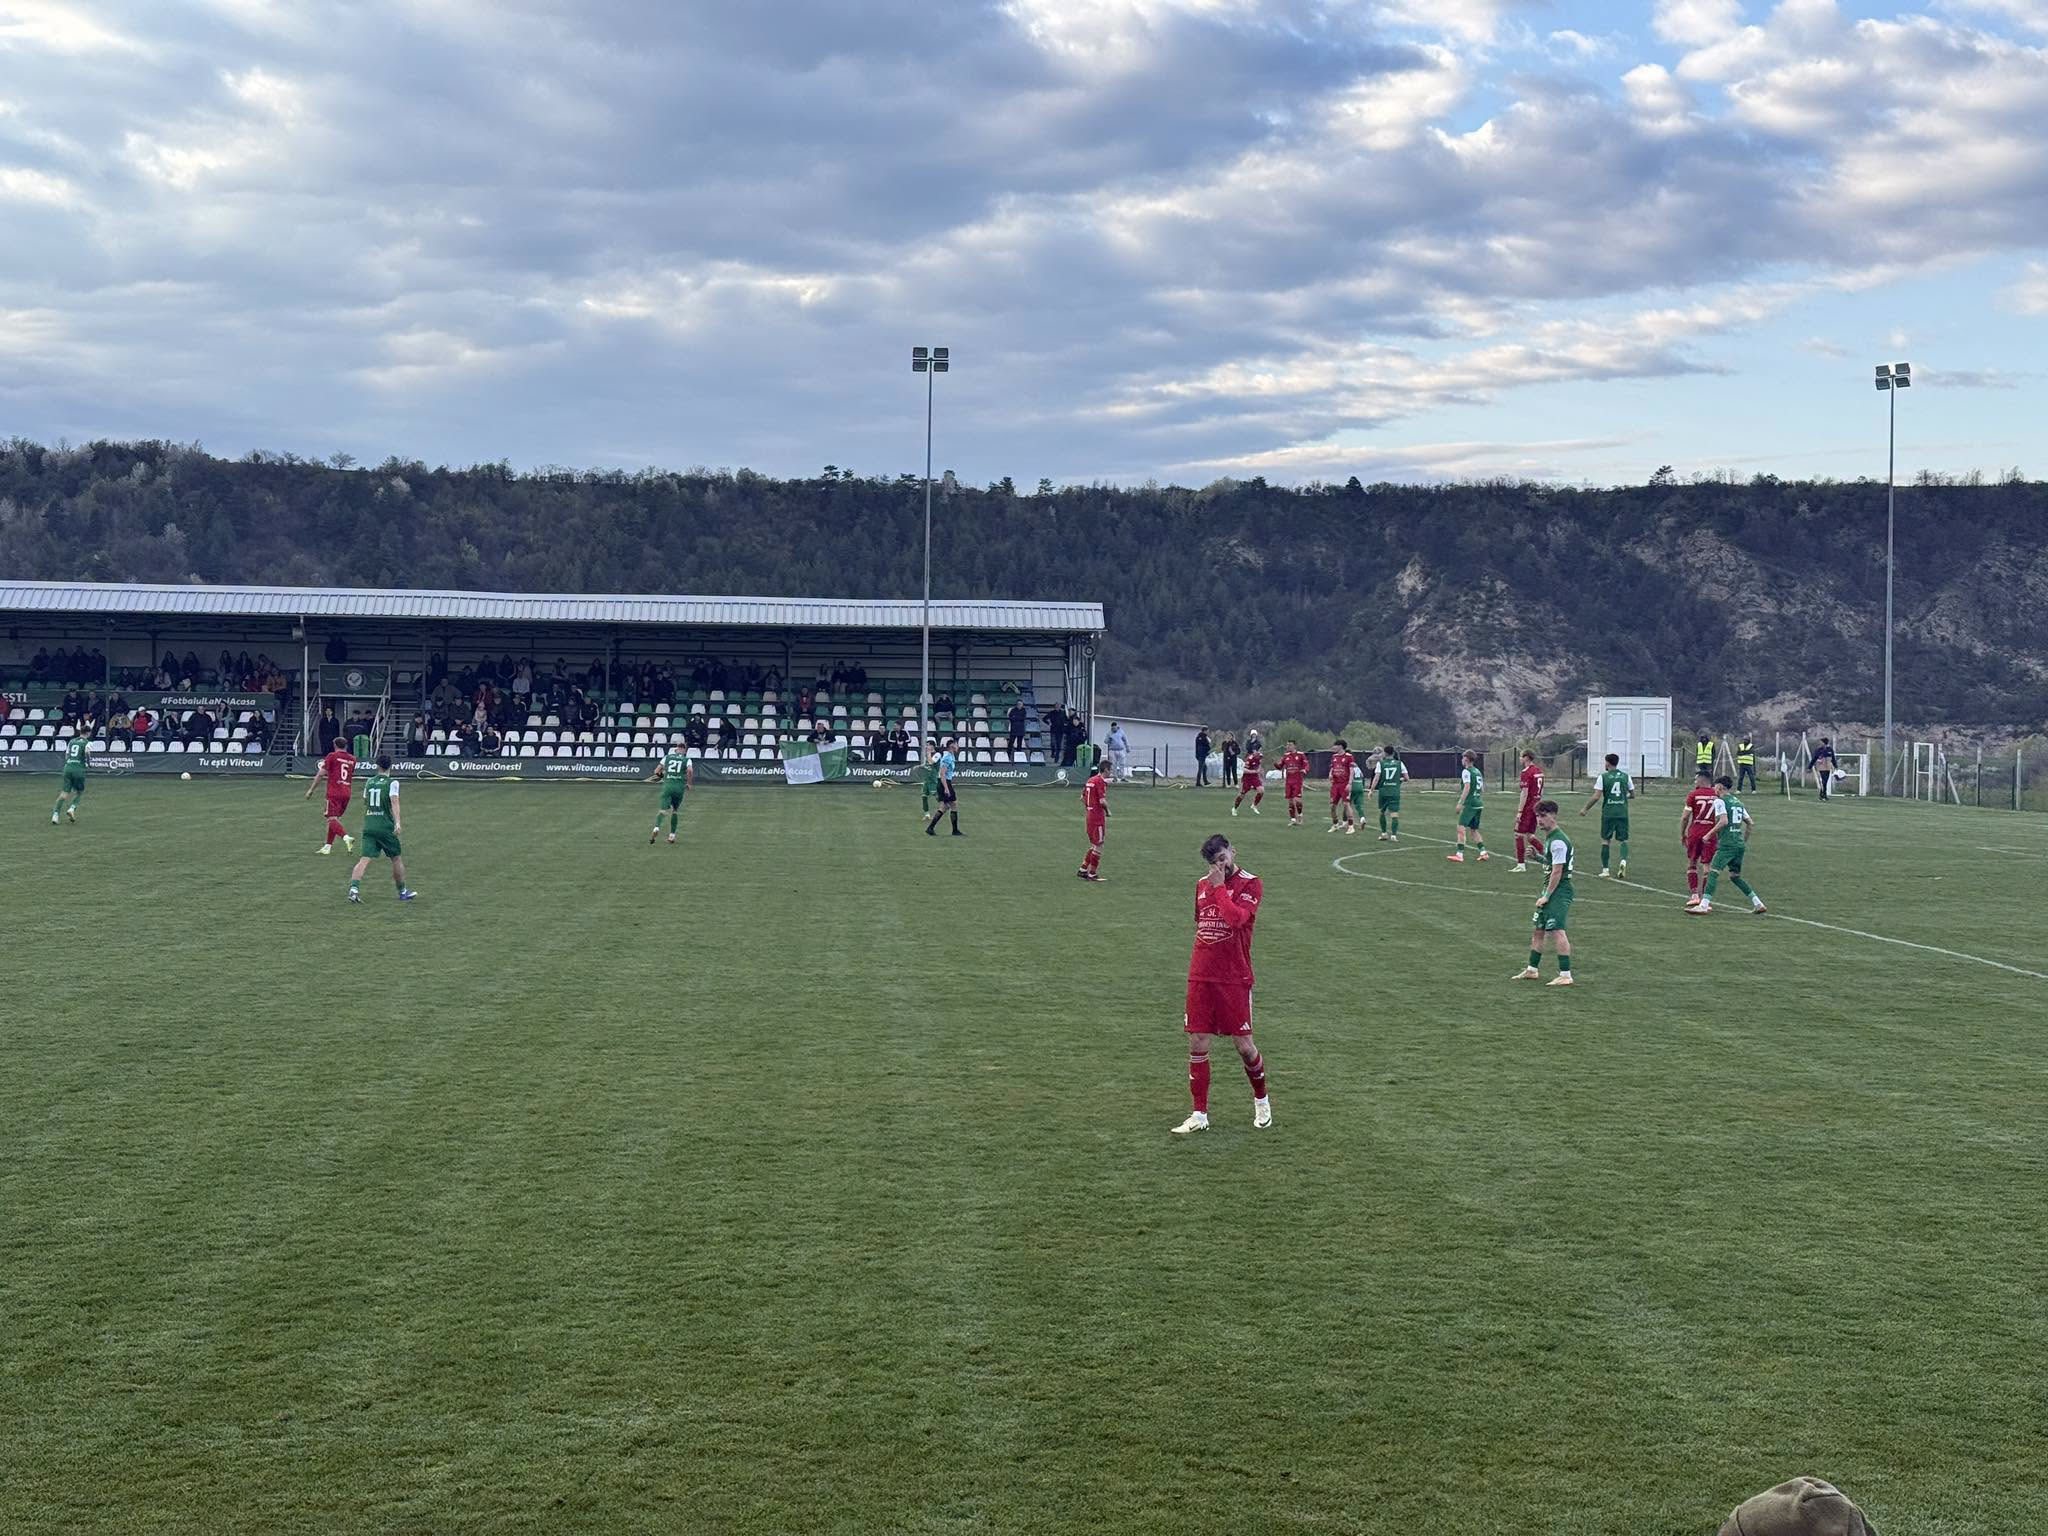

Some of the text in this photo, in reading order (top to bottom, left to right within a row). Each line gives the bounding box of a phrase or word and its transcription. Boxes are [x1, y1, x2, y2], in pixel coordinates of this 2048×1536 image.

[70, 744, 80, 758] 9
[199, 758, 209, 767] Tu
[229, 759, 264, 768] Viitorul
[460, 762, 522, 771] ViitorulOnesti
[545, 763, 640, 774] www.viitorulonesti.ro
[667, 759, 683, 773] 21
[340, 763, 349, 781] 6
[852, 768, 912, 777] ViitorulOnesti
[1384, 767, 1397, 780] 17
[1611, 781, 1622, 797] 4
[369, 788, 381, 807] 11
[1696, 799, 1715, 820] 77
